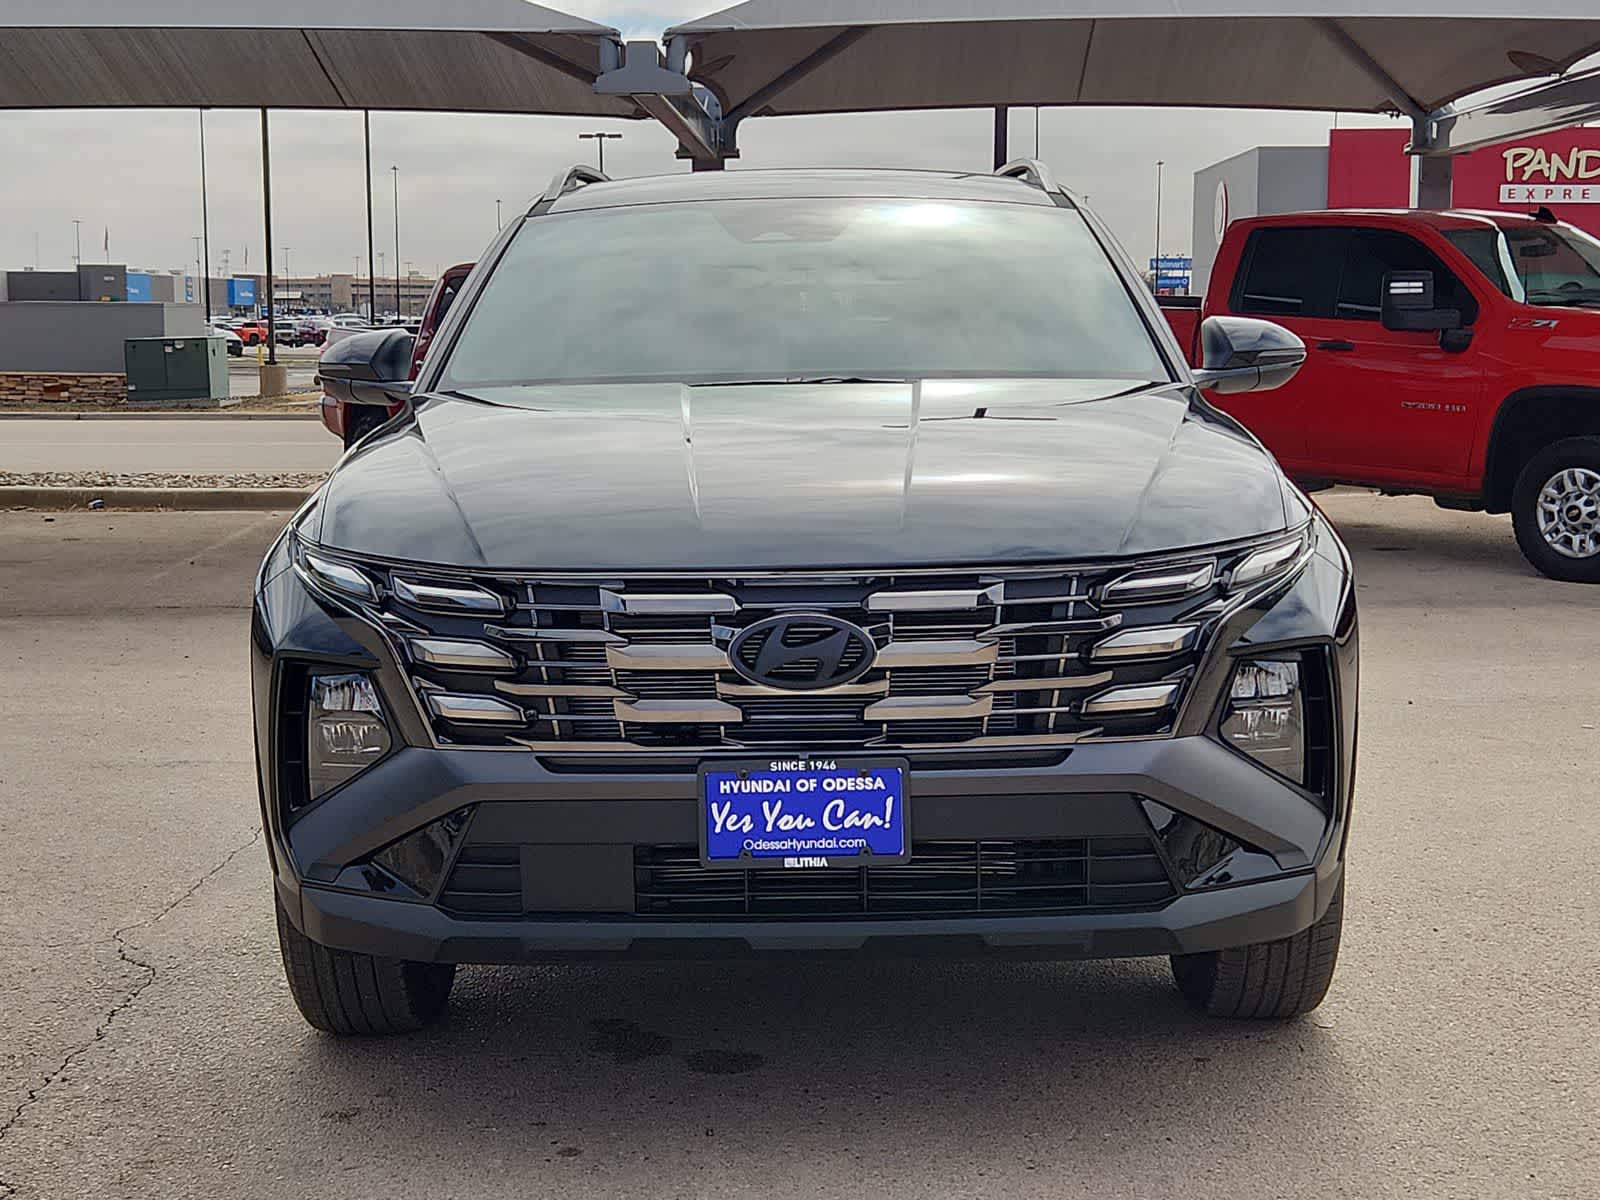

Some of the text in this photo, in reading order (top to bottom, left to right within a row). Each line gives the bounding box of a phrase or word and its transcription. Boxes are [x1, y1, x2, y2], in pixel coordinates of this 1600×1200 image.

[1502, 147, 1600, 182] PAND
[770, 760, 837, 771] SINCE 1946
[719, 777, 886, 794] HYUNDAI OF ODESSA
[711, 795, 894, 833] Yes You Can!
[743, 837, 867, 851] OdessaHyundai.com
